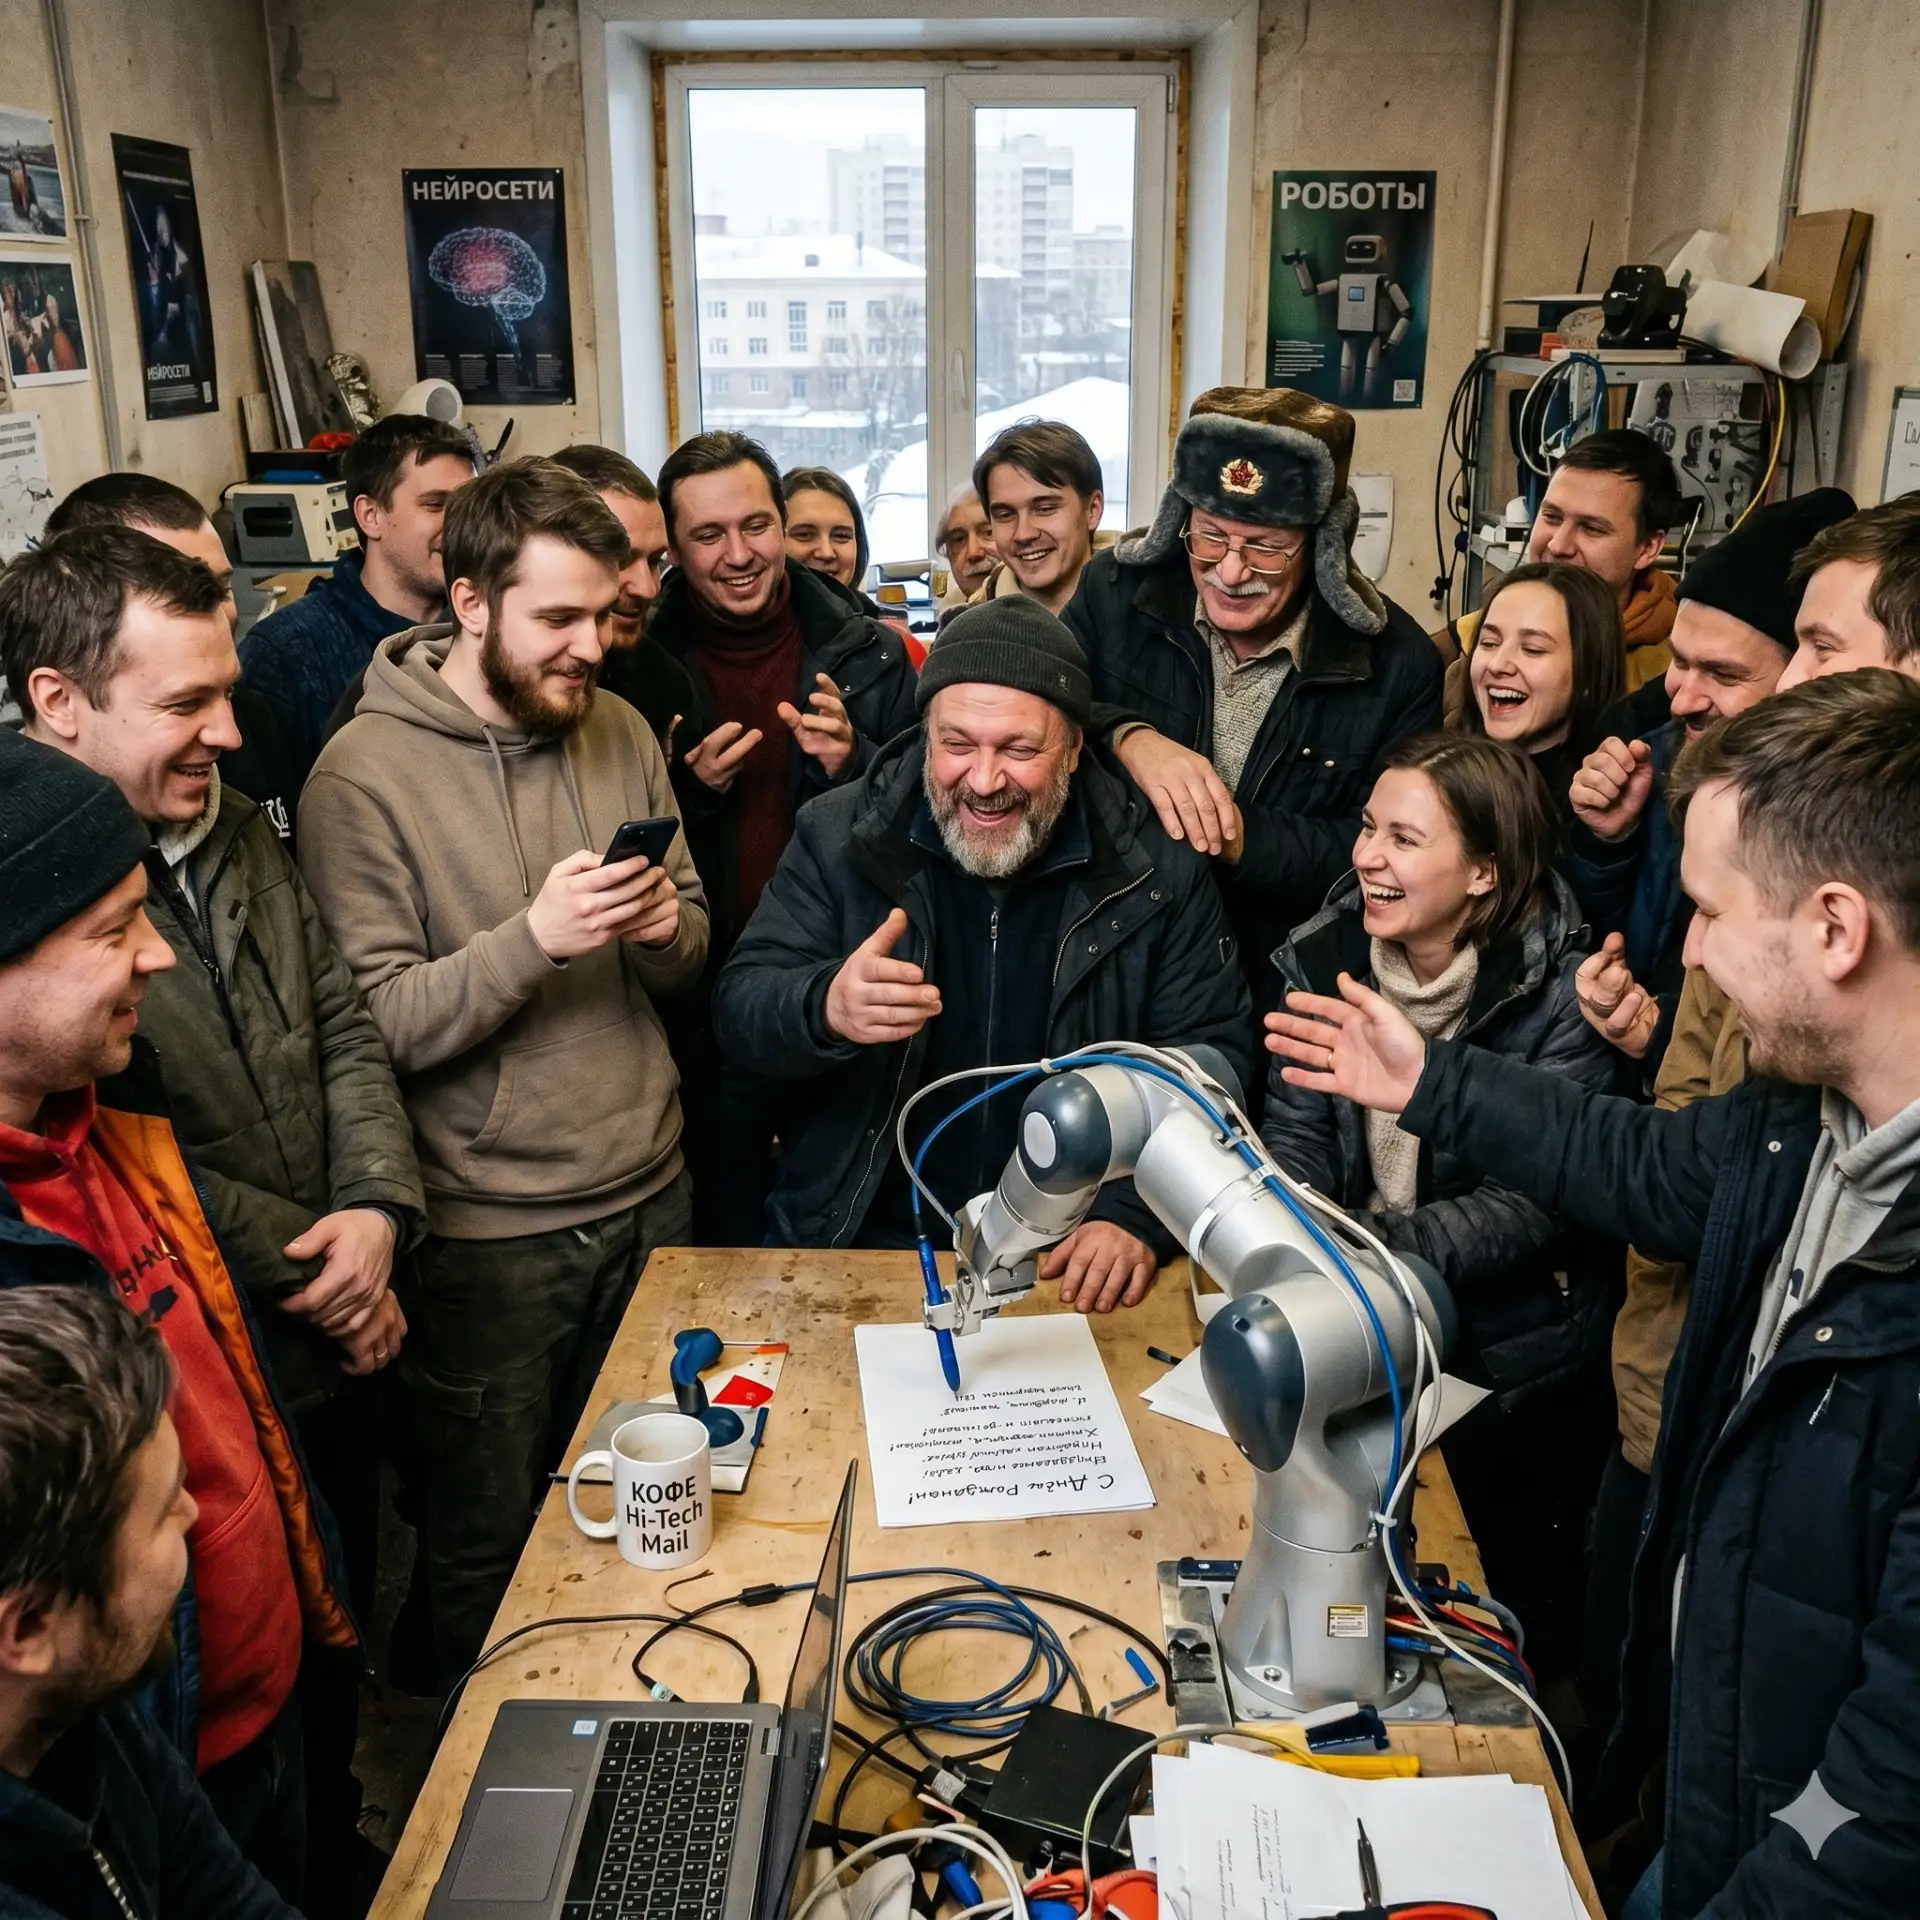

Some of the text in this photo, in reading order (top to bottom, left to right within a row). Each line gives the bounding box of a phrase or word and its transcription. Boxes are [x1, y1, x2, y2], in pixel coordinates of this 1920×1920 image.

[412, 174, 555, 201] НЕЙРОСЕТИ
[1280, 181, 1426, 210] РОБОТЫ
[631, 1475, 697, 1505] КОФЕ
[1097, 1473, 1115, 1490] С
[626, 1499, 704, 1530] Hi-Tech
[641, 1529, 690, 1555] Mail
